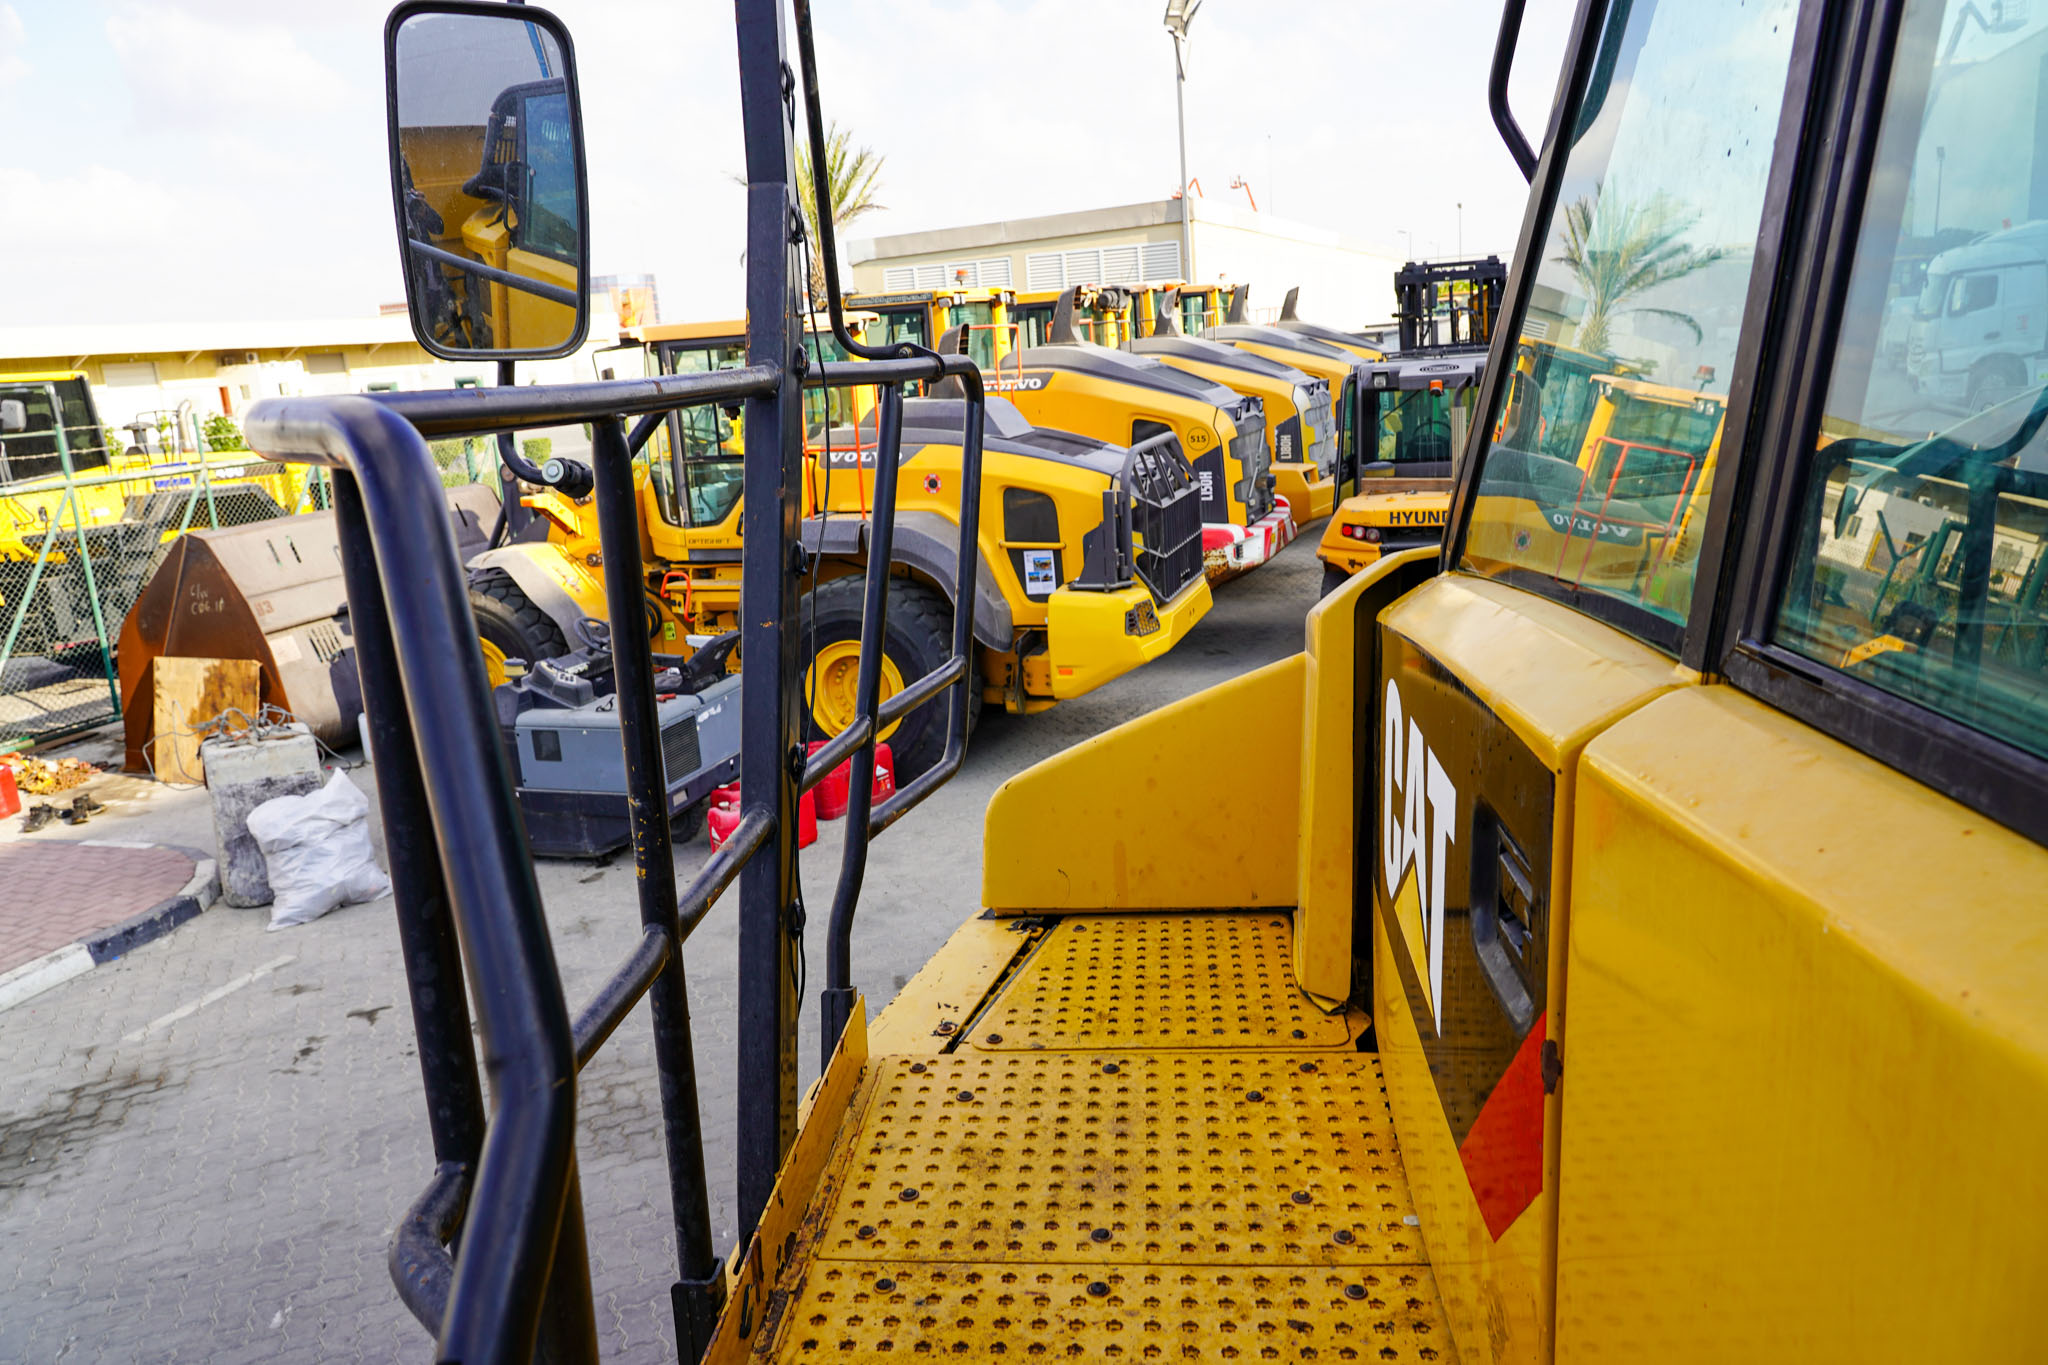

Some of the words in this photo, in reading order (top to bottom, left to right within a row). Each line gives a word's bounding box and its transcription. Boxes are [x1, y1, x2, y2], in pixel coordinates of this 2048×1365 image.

[1190, 435, 1207, 443] 515
[1199, 471, 1213, 501] L150H
[1383, 678, 1457, 1039] CAT
